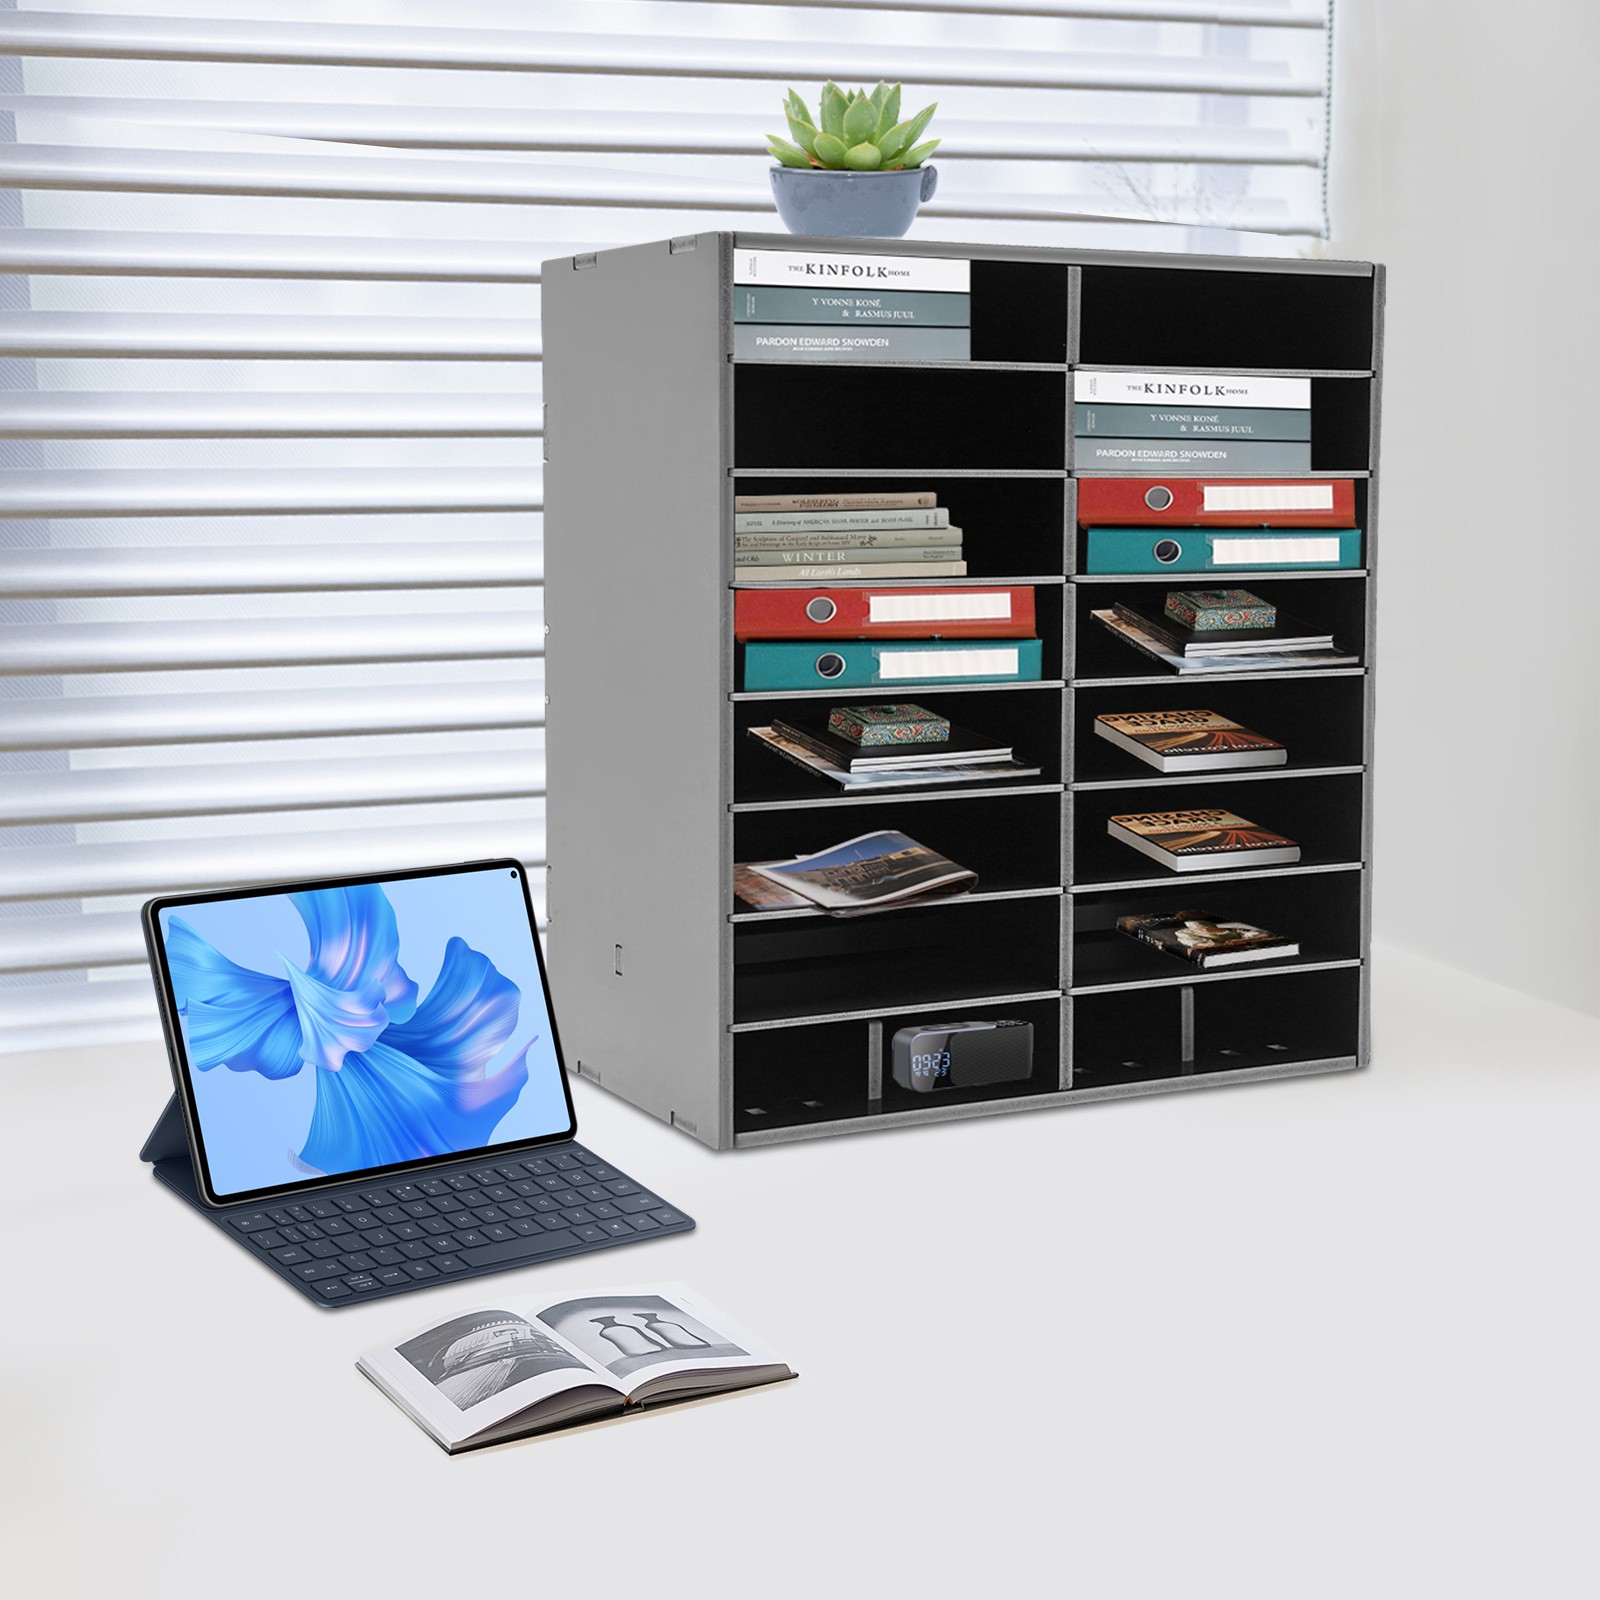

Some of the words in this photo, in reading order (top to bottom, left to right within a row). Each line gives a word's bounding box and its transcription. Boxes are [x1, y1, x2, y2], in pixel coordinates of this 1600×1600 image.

[806, 264, 888, 278] KINFOLK
[821, 298, 854, 306] VONNE
[855, 298, 882, 308] KONÉ
[842, 310, 849, 318] &
[855, 310, 892, 318] RASMUS
[892, 311, 916, 319] JUUL
[756, 337, 798, 346] PARDON
[799, 338, 841, 346] EDWARD
[842, 338, 890, 347] SNOWDEN
[1144, 383, 1226, 396] KINFOLK
[1158, 414, 1192, 422] VONNE
[1192, 415, 1220, 424] KONÉ
[1192, 424, 1230, 432] RASMUS
[1231, 426, 1254, 434] JUUL
[1096, 449, 1136, 458] PARDON
[1138, 450, 1178, 458] EDWARD
[1180, 450, 1228, 459] SNOWDEN
[782, 552, 846, 562] WINTER
